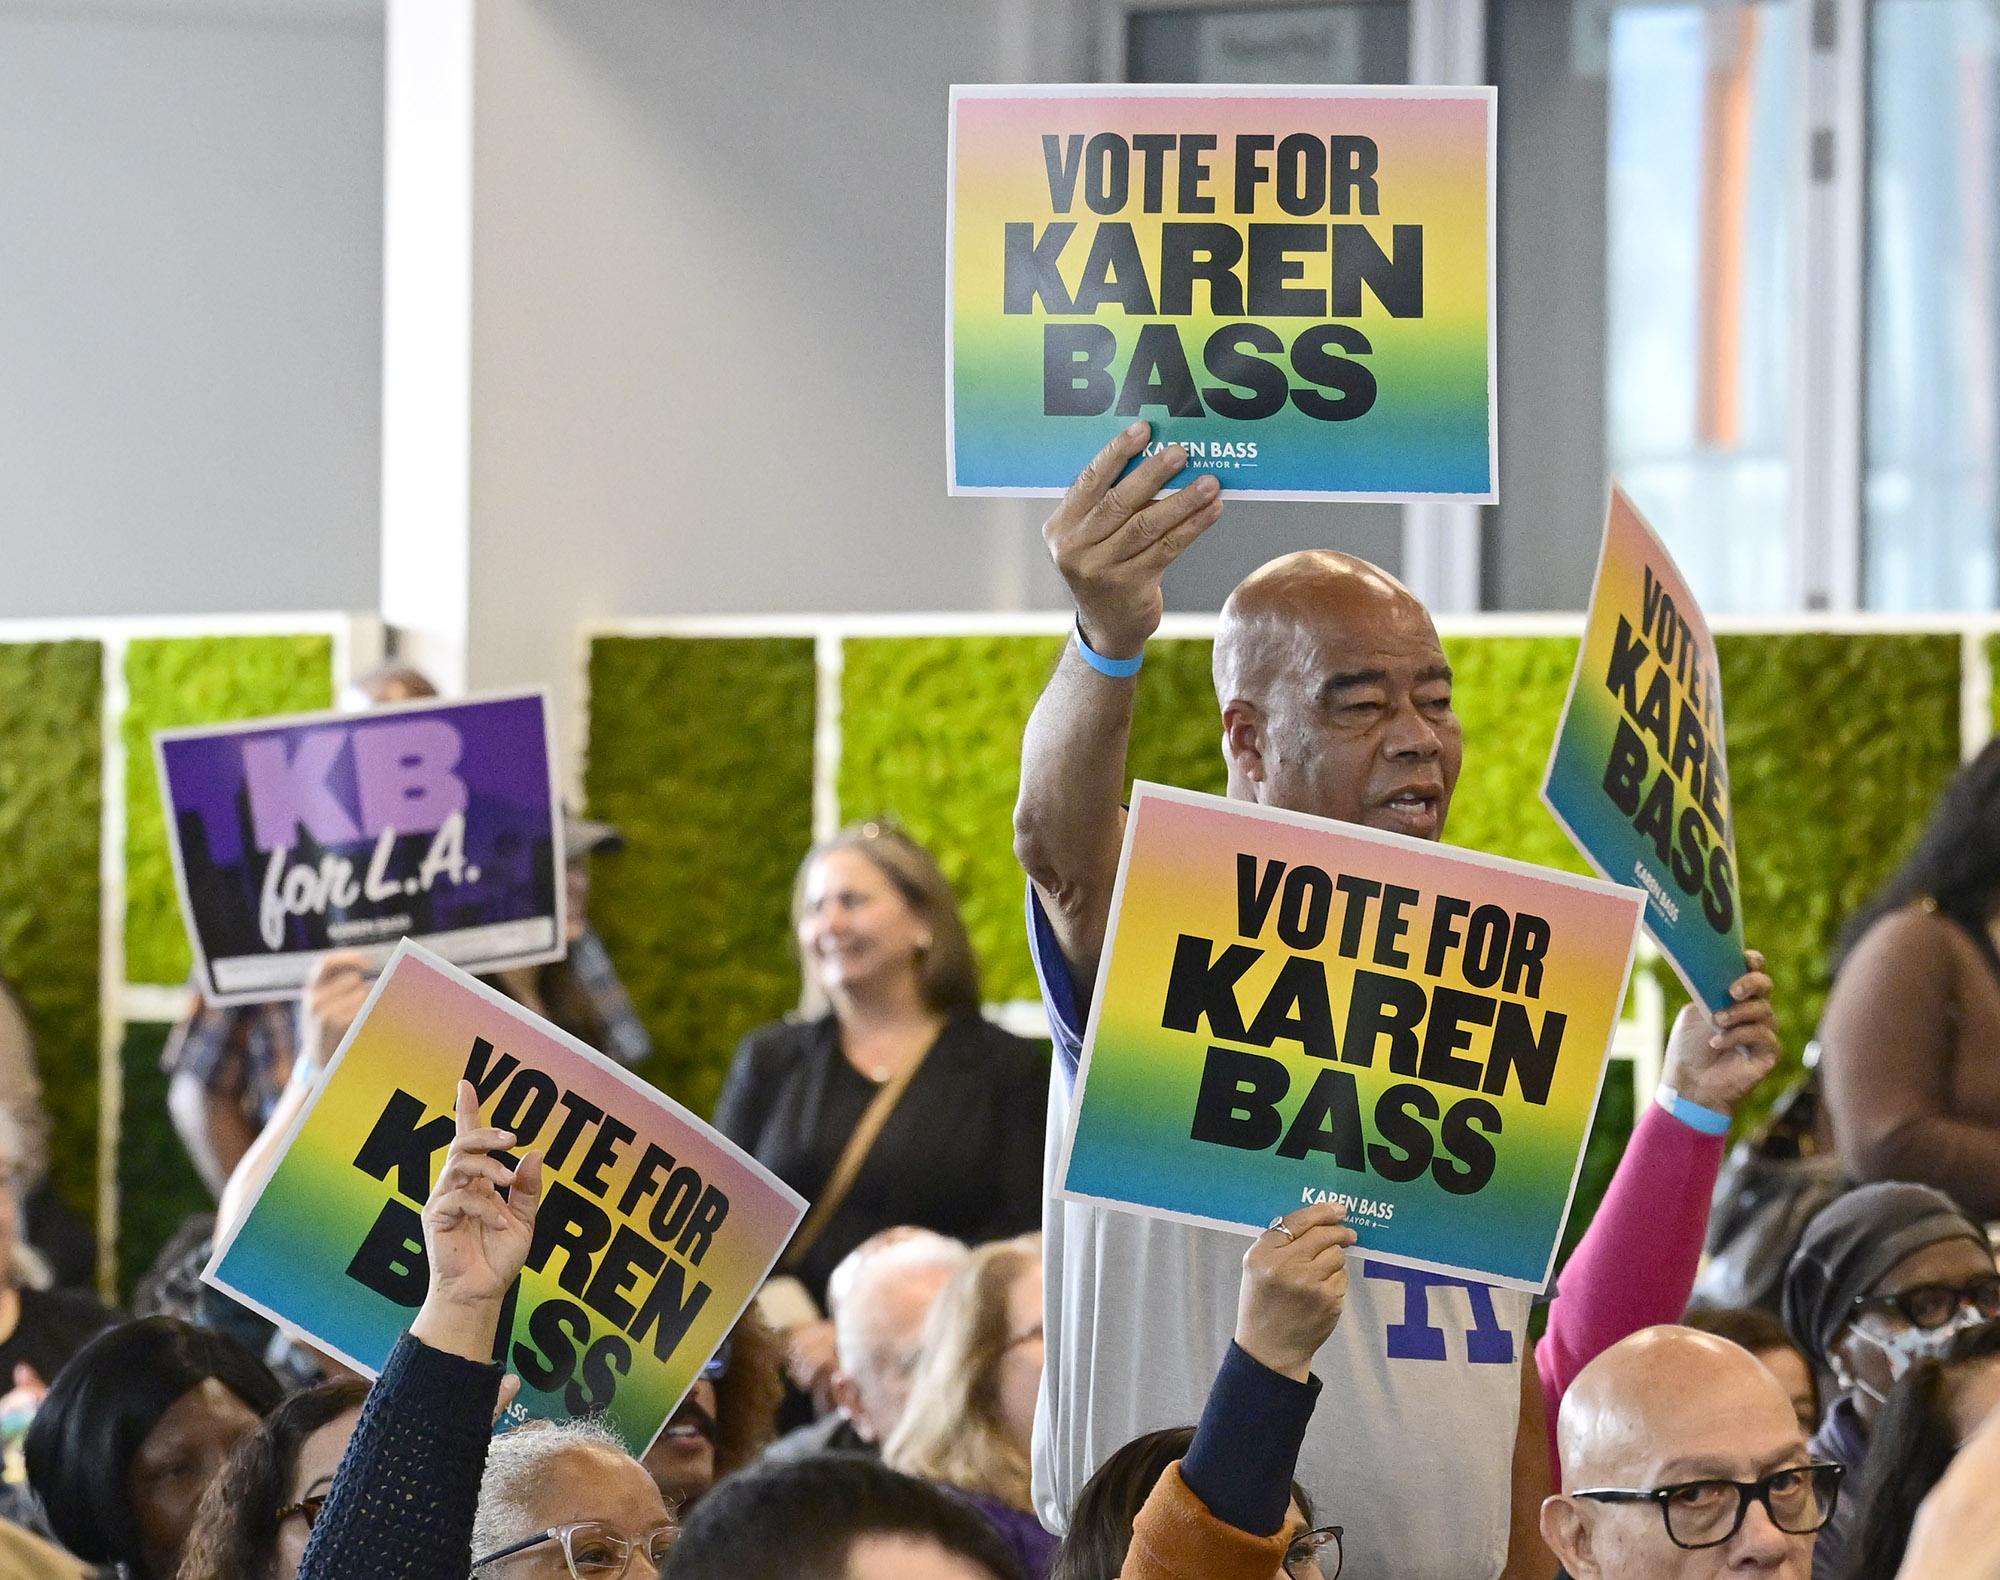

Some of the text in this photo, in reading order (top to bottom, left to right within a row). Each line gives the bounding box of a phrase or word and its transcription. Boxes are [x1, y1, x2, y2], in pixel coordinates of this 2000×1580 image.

[1042, 133, 1380, 216] VOTE FOR
[1003, 222, 1424, 319] KAREN
[1043, 323, 1378, 421] BASS
[1193, 460, 1230, 468] MAYOR
[1211, 442, 1257, 458] BASS
[242, 718, 468, 852] KB
[1605, 613, 1734, 855] KARE
[259, 812, 483, 951] for L.A.
[1602, 715, 1735, 935] BASS
[1236, 853, 1551, 999] VOTE FOR
[1161, 933, 1568, 1106] KAREN
[454, 1036, 730, 1267] VOTE FOR
[1190, 1045, 1503, 1196] BASS
[1359, 1199, 1394, 1220] BASS
[344, 1197, 632, 1420] BSS
[505, 1400, 529, 1422] ASS
